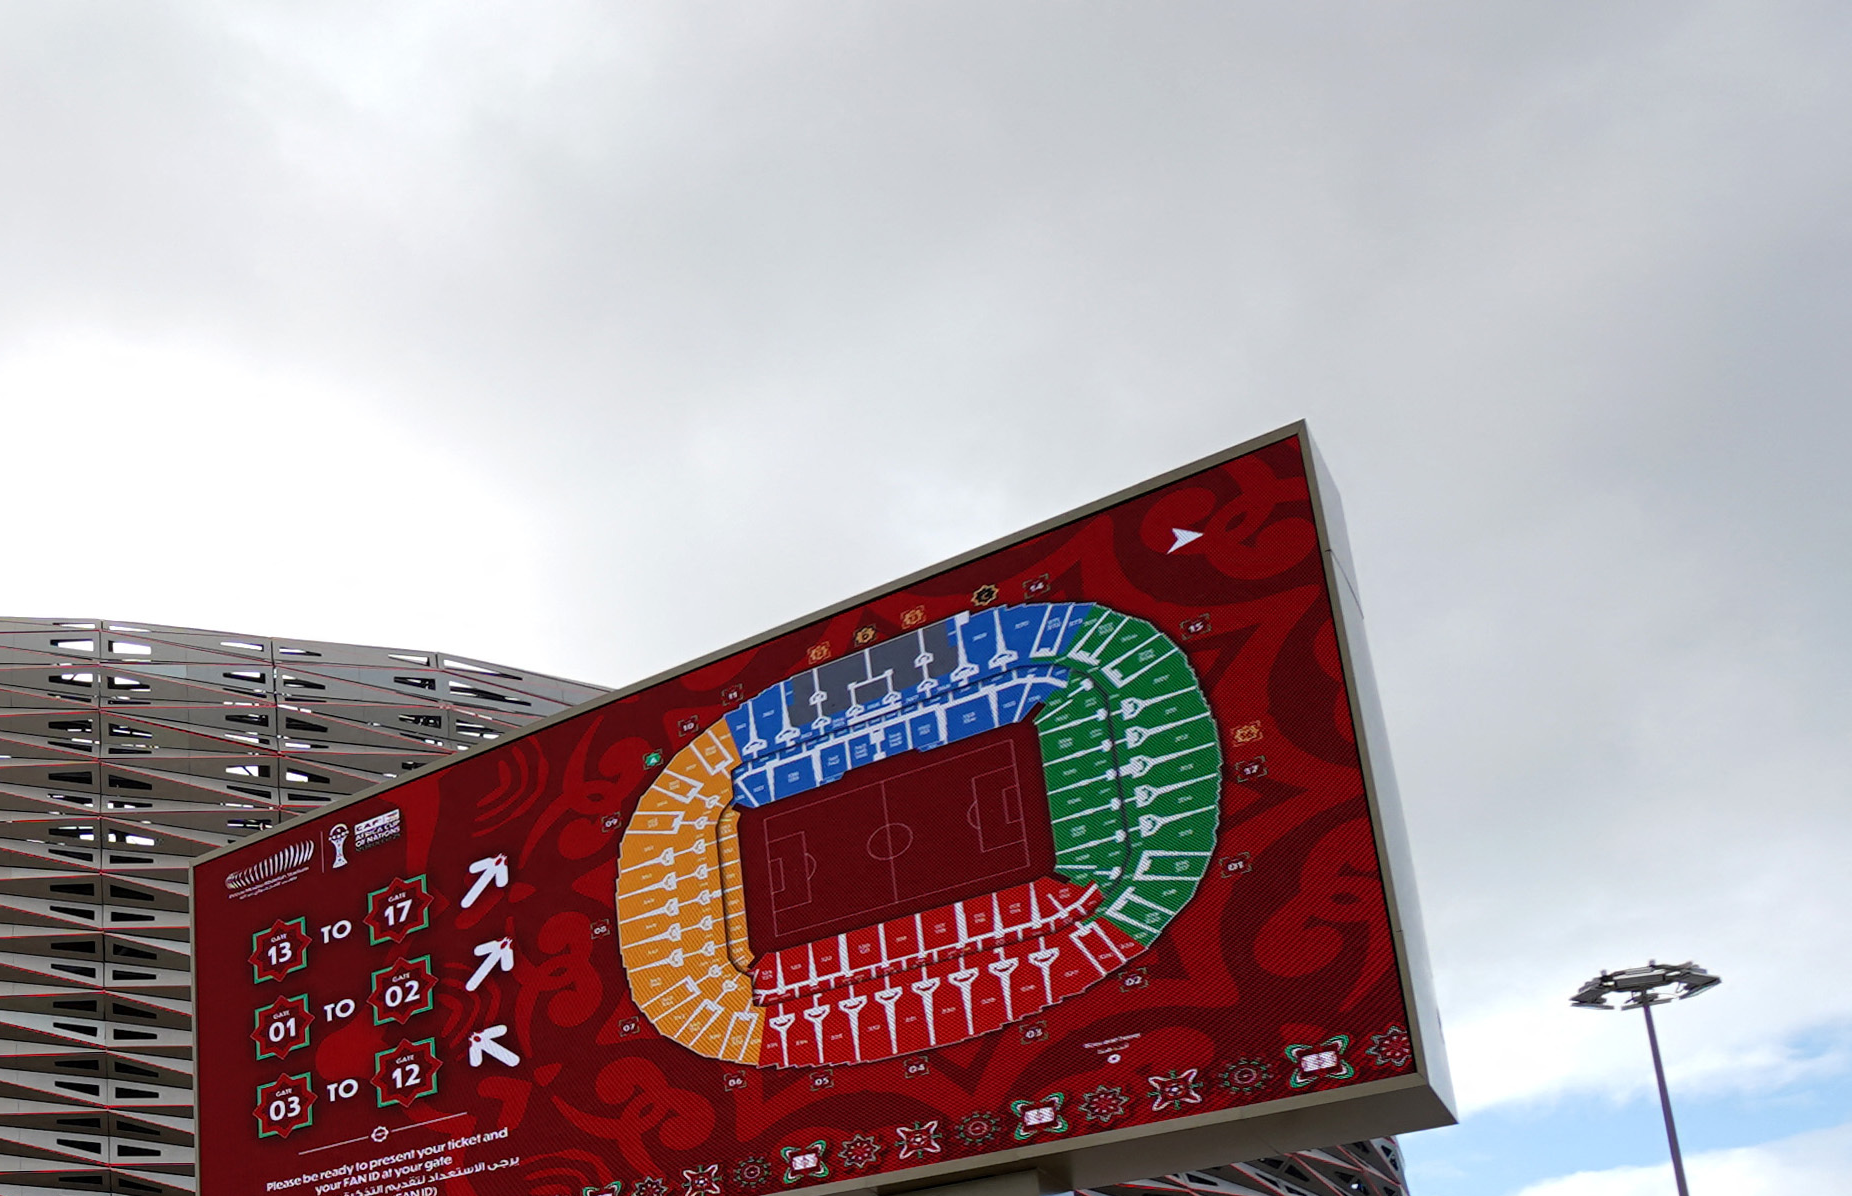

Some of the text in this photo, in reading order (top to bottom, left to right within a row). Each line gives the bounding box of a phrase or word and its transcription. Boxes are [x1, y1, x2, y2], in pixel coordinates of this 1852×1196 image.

[388, 892, 406, 903] GATE
[267, 899, 413, 966] 13 TO 17
[270, 933, 287, 943] GATE
[392, 972, 411, 983] GATE
[268, 980, 420, 1042] 01 TO 02
[273, 1010, 290, 1020] GATE
[395, 1054, 414, 1065] GATE
[269, 1063, 421, 1121] 03 TO 12
[275, 1088, 292, 1098] GATE
[266, 1127, 509, 1192] Please be ready to present your ticket and
[487, 1156, 520, 1172] يرجى
[314, 1155, 453, 1196] your FAN ID at your gate
[427, 1160, 486, 1184] الاستعداد
[384, 1173, 426, 1195] لتقديم
